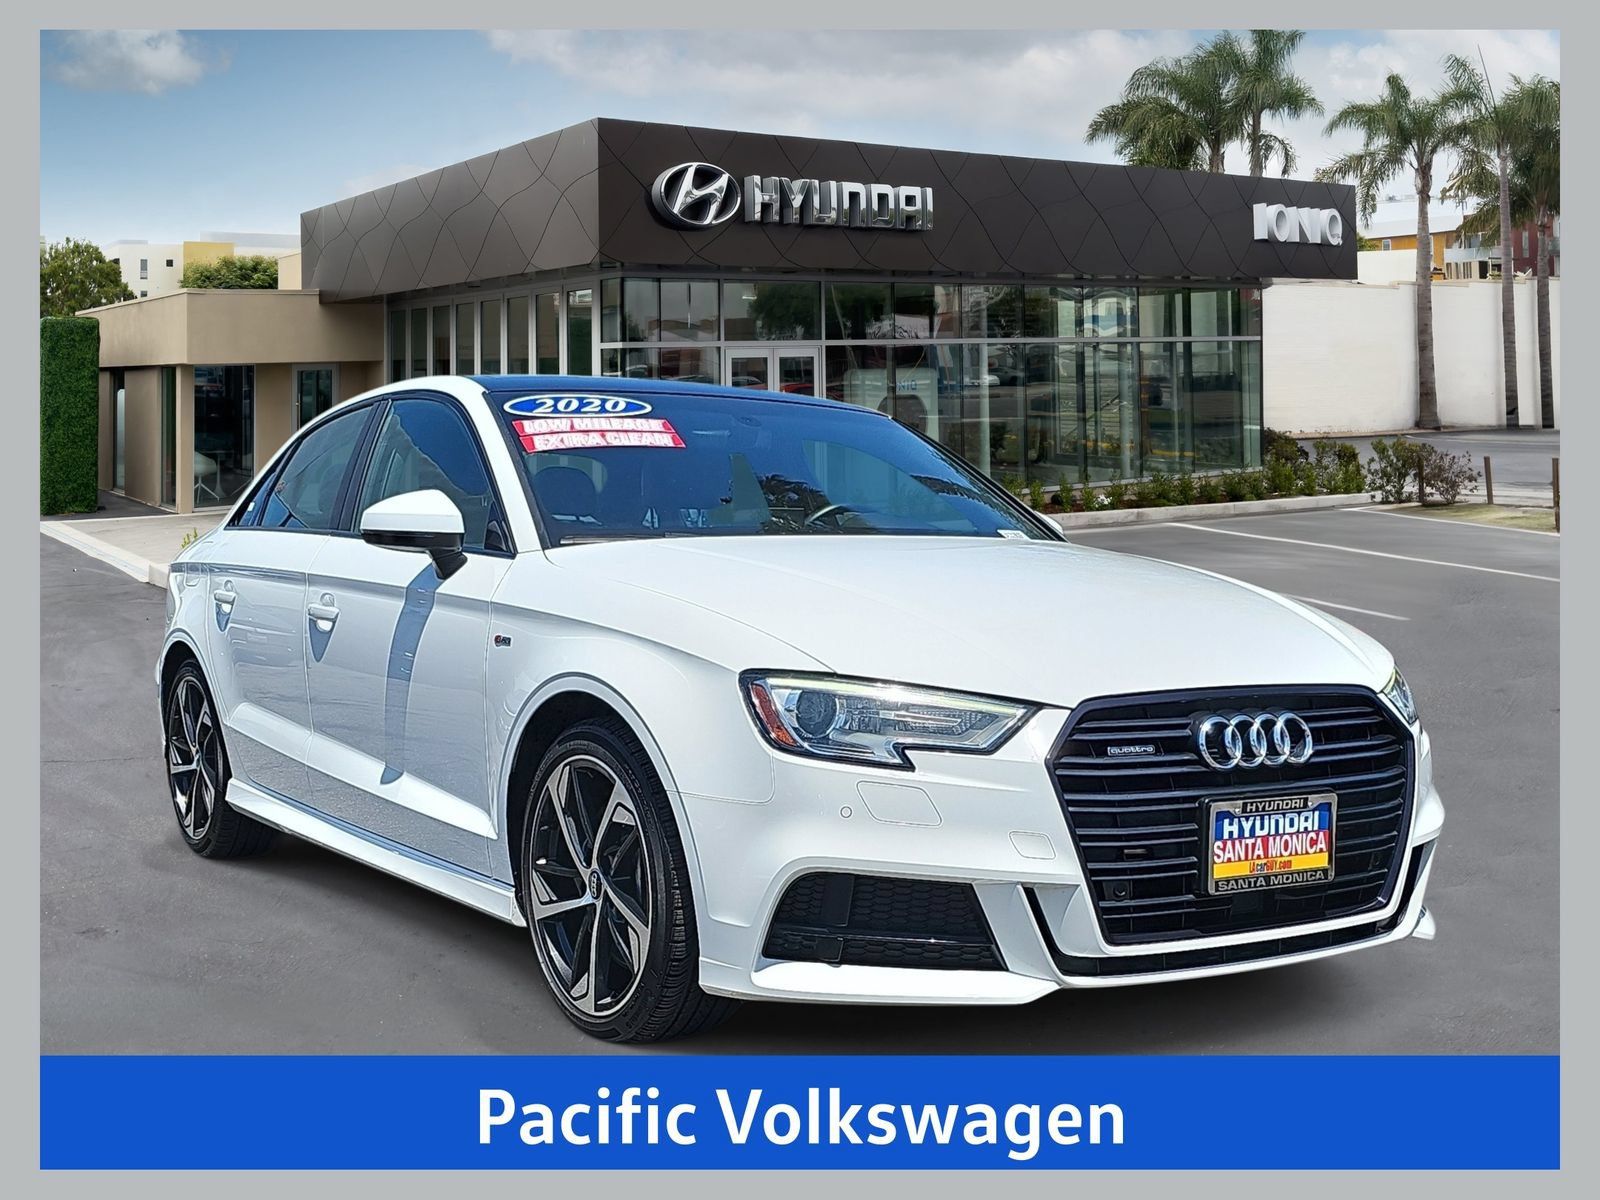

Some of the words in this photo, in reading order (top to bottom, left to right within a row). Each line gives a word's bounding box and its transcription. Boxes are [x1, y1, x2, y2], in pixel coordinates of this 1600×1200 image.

[744, 175, 933, 230] HYUNDAI
[1253, 203, 1342, 246] IONIQ
[532, 398, 627, 414] 2020
[524, 419, 571, 434] LOW
[573, 418, 663, 432] MILEAGE
[606, 432, 674, 447] CLEAN
[1110, 745, 1154, 754] quattro
[1246, 799, 1304, 812] HYUNDAI
[1223, 811, 1319, 839] HYUNDAI
[1213, 839, 1265, 863] SANTA
[1268, 832, 1327, 857] MONICA
[1218, 877, 1266, 891] SANTA
[1269, 870, 1325, 886] MONICA
